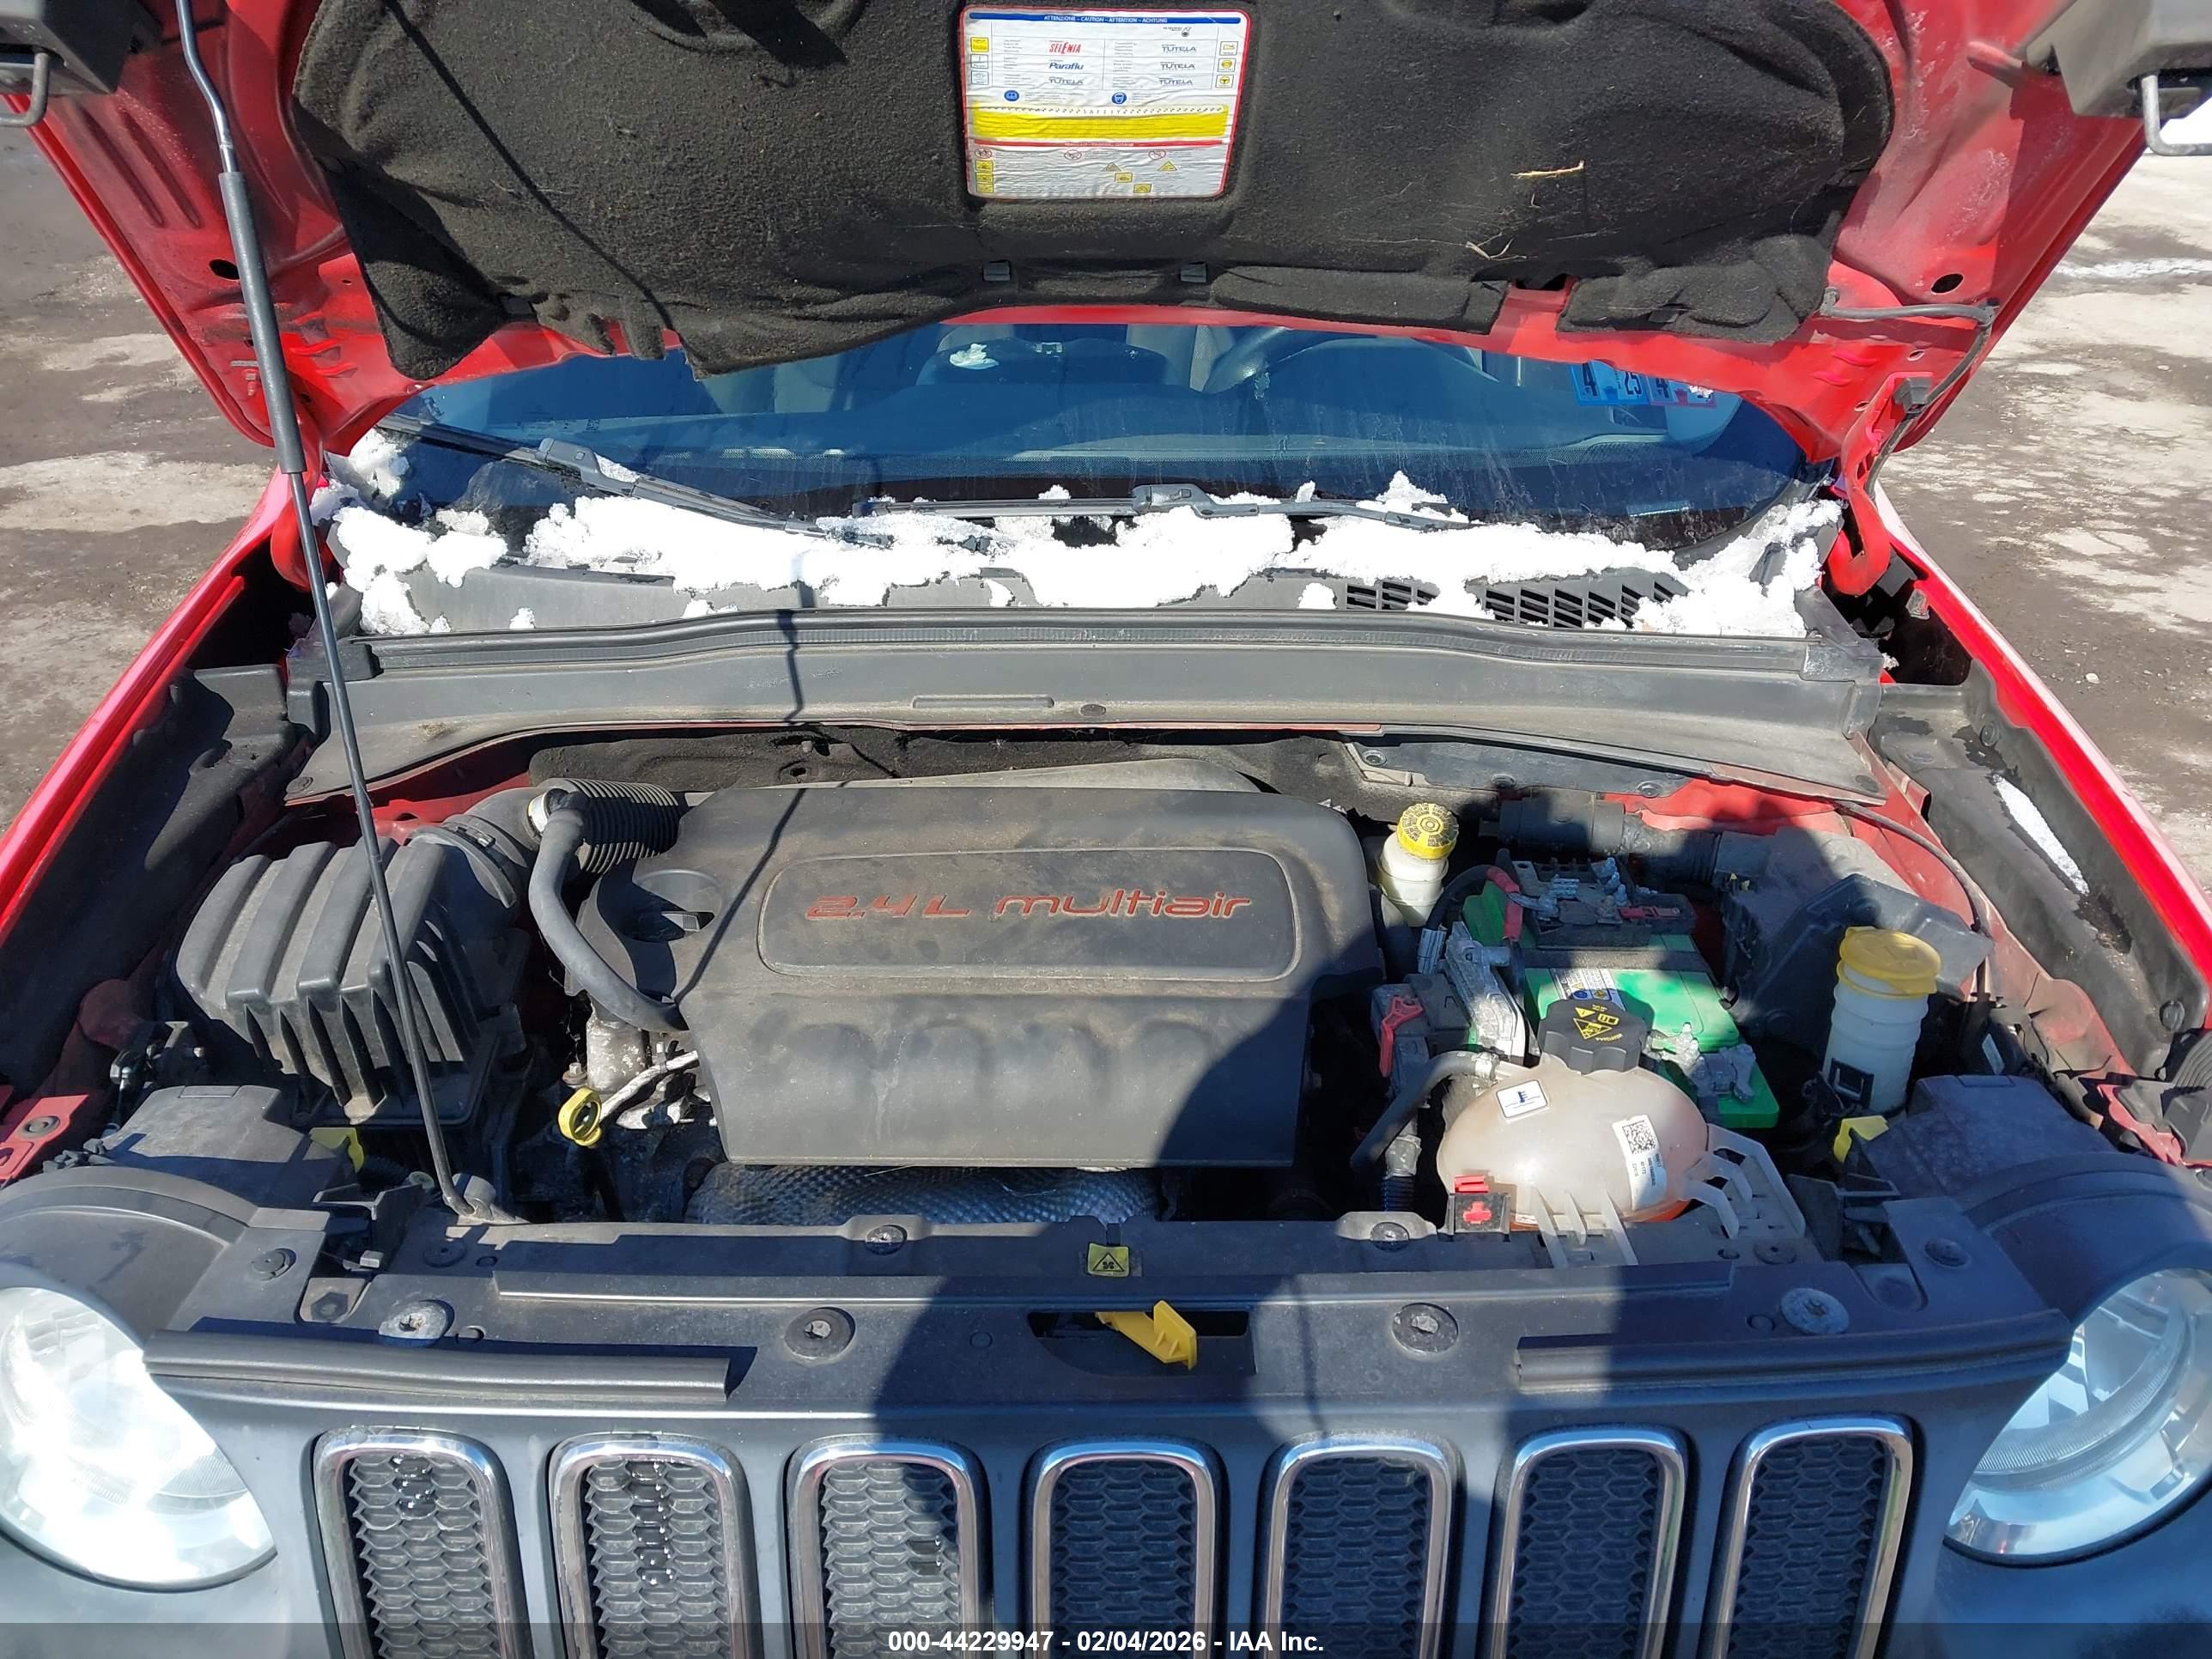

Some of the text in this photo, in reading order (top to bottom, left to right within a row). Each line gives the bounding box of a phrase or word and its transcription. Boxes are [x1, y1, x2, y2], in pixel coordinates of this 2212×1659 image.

[1049, 42, 1081, 54] SELENIA
[1048, 62, 1085, 70] Paraflu
[994, 887, 1251, 921] multiair
